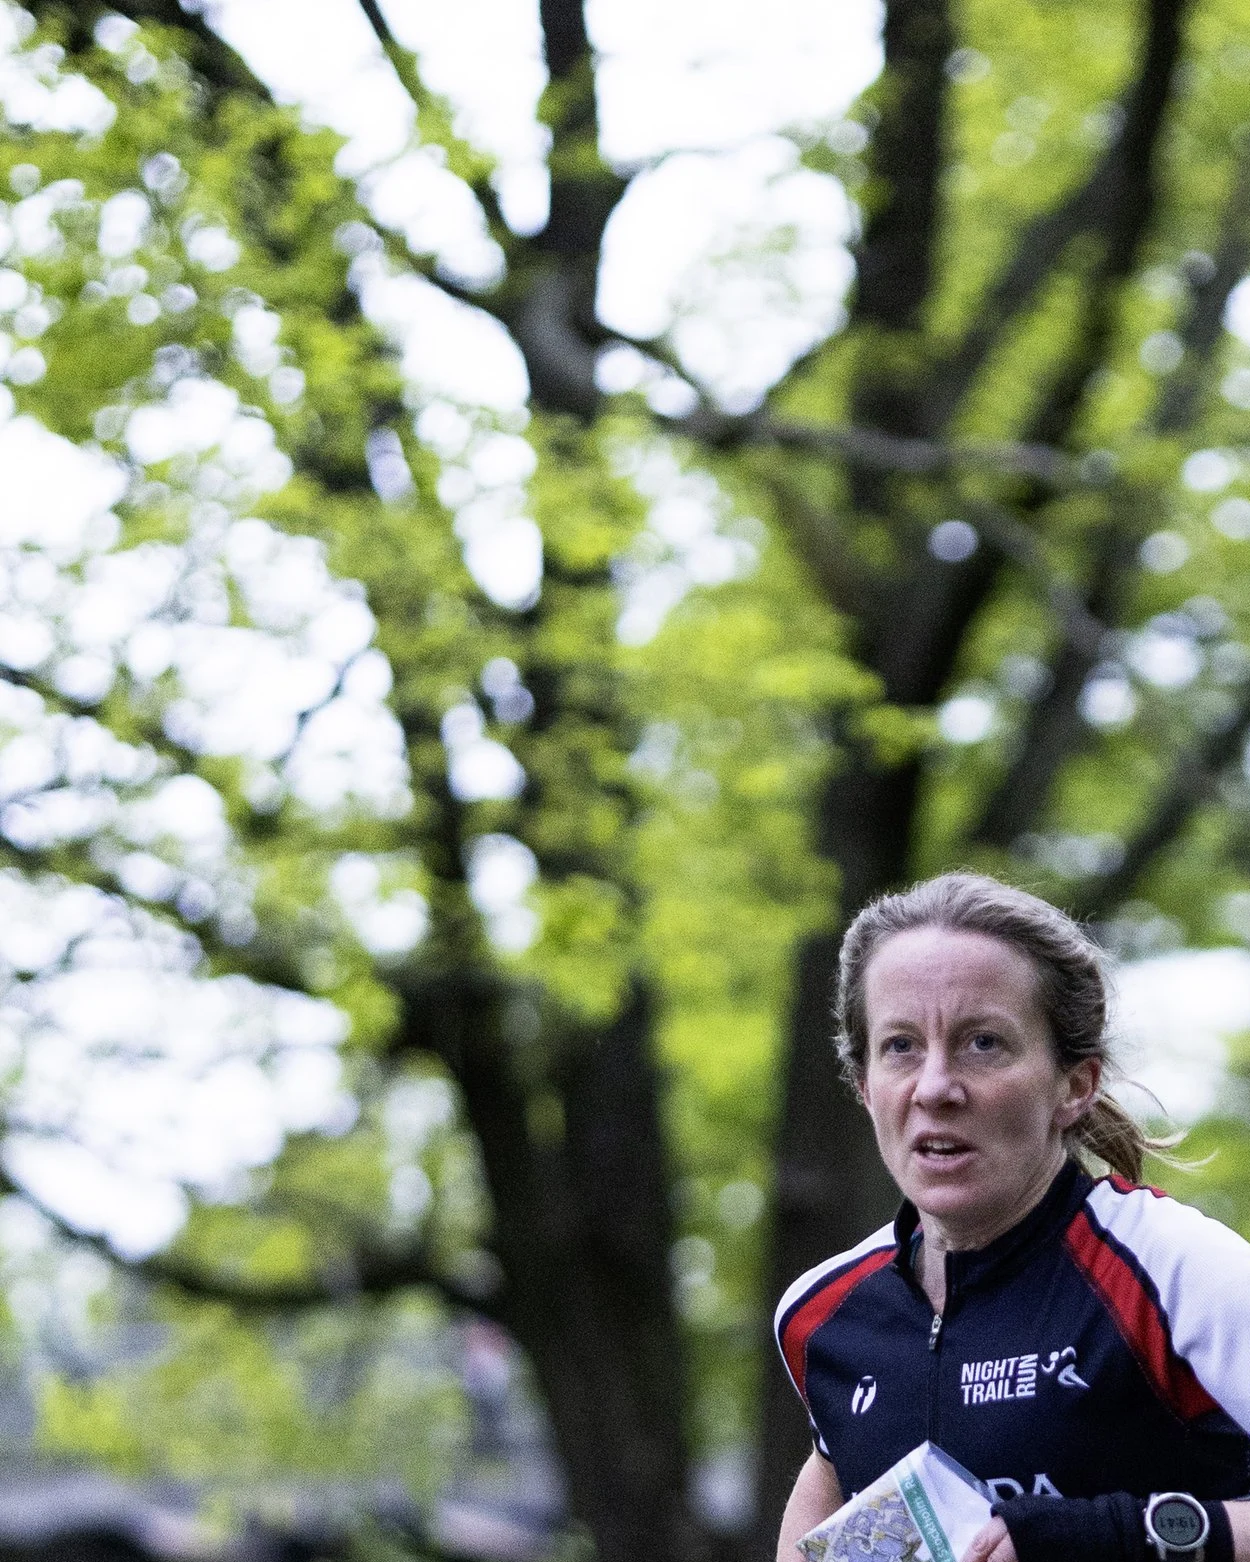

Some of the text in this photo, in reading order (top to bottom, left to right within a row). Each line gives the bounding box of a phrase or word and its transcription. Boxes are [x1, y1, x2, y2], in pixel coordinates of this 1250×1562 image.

[961, 1357, 1019, 1384] NIGHT
[1015, 1354, 1038, 1398] RUN
[961, 1379, 1015, 1405] TRAIL
